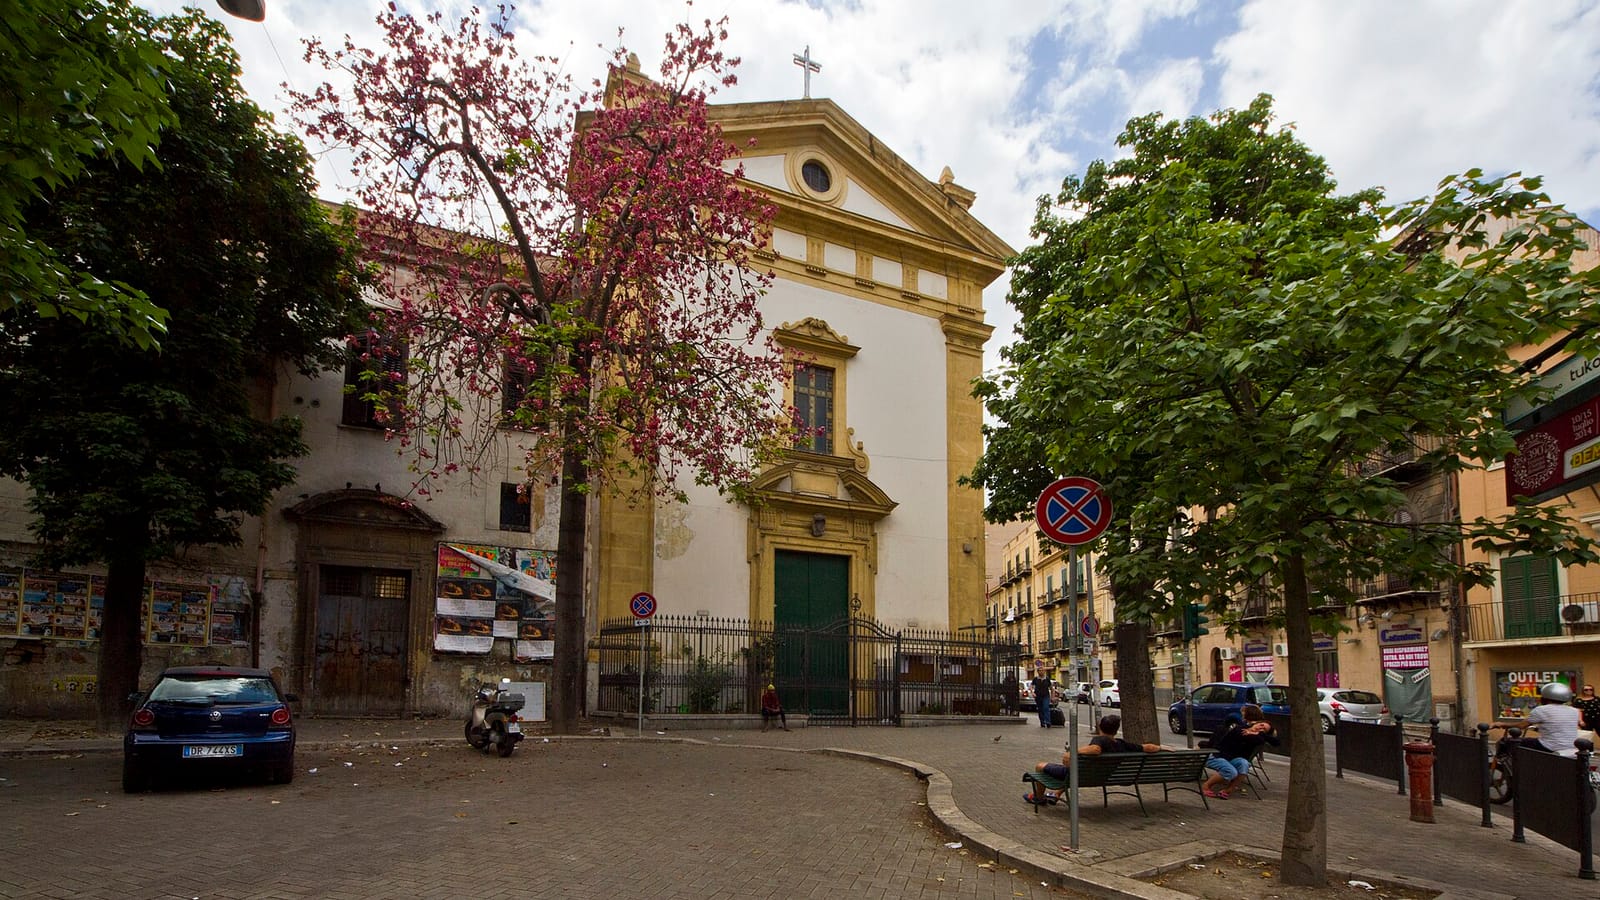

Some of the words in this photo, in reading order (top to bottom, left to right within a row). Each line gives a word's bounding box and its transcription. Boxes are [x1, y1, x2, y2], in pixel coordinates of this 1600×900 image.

[1571, 409, 1592, 424] 10/15
[1572, 418, 1594, 433] luglio
[1574, 427, 1592, 441] 2014
[1508, 671, 1560, 683] OUTLET
[1510, 686, 1543, 698] SAL
